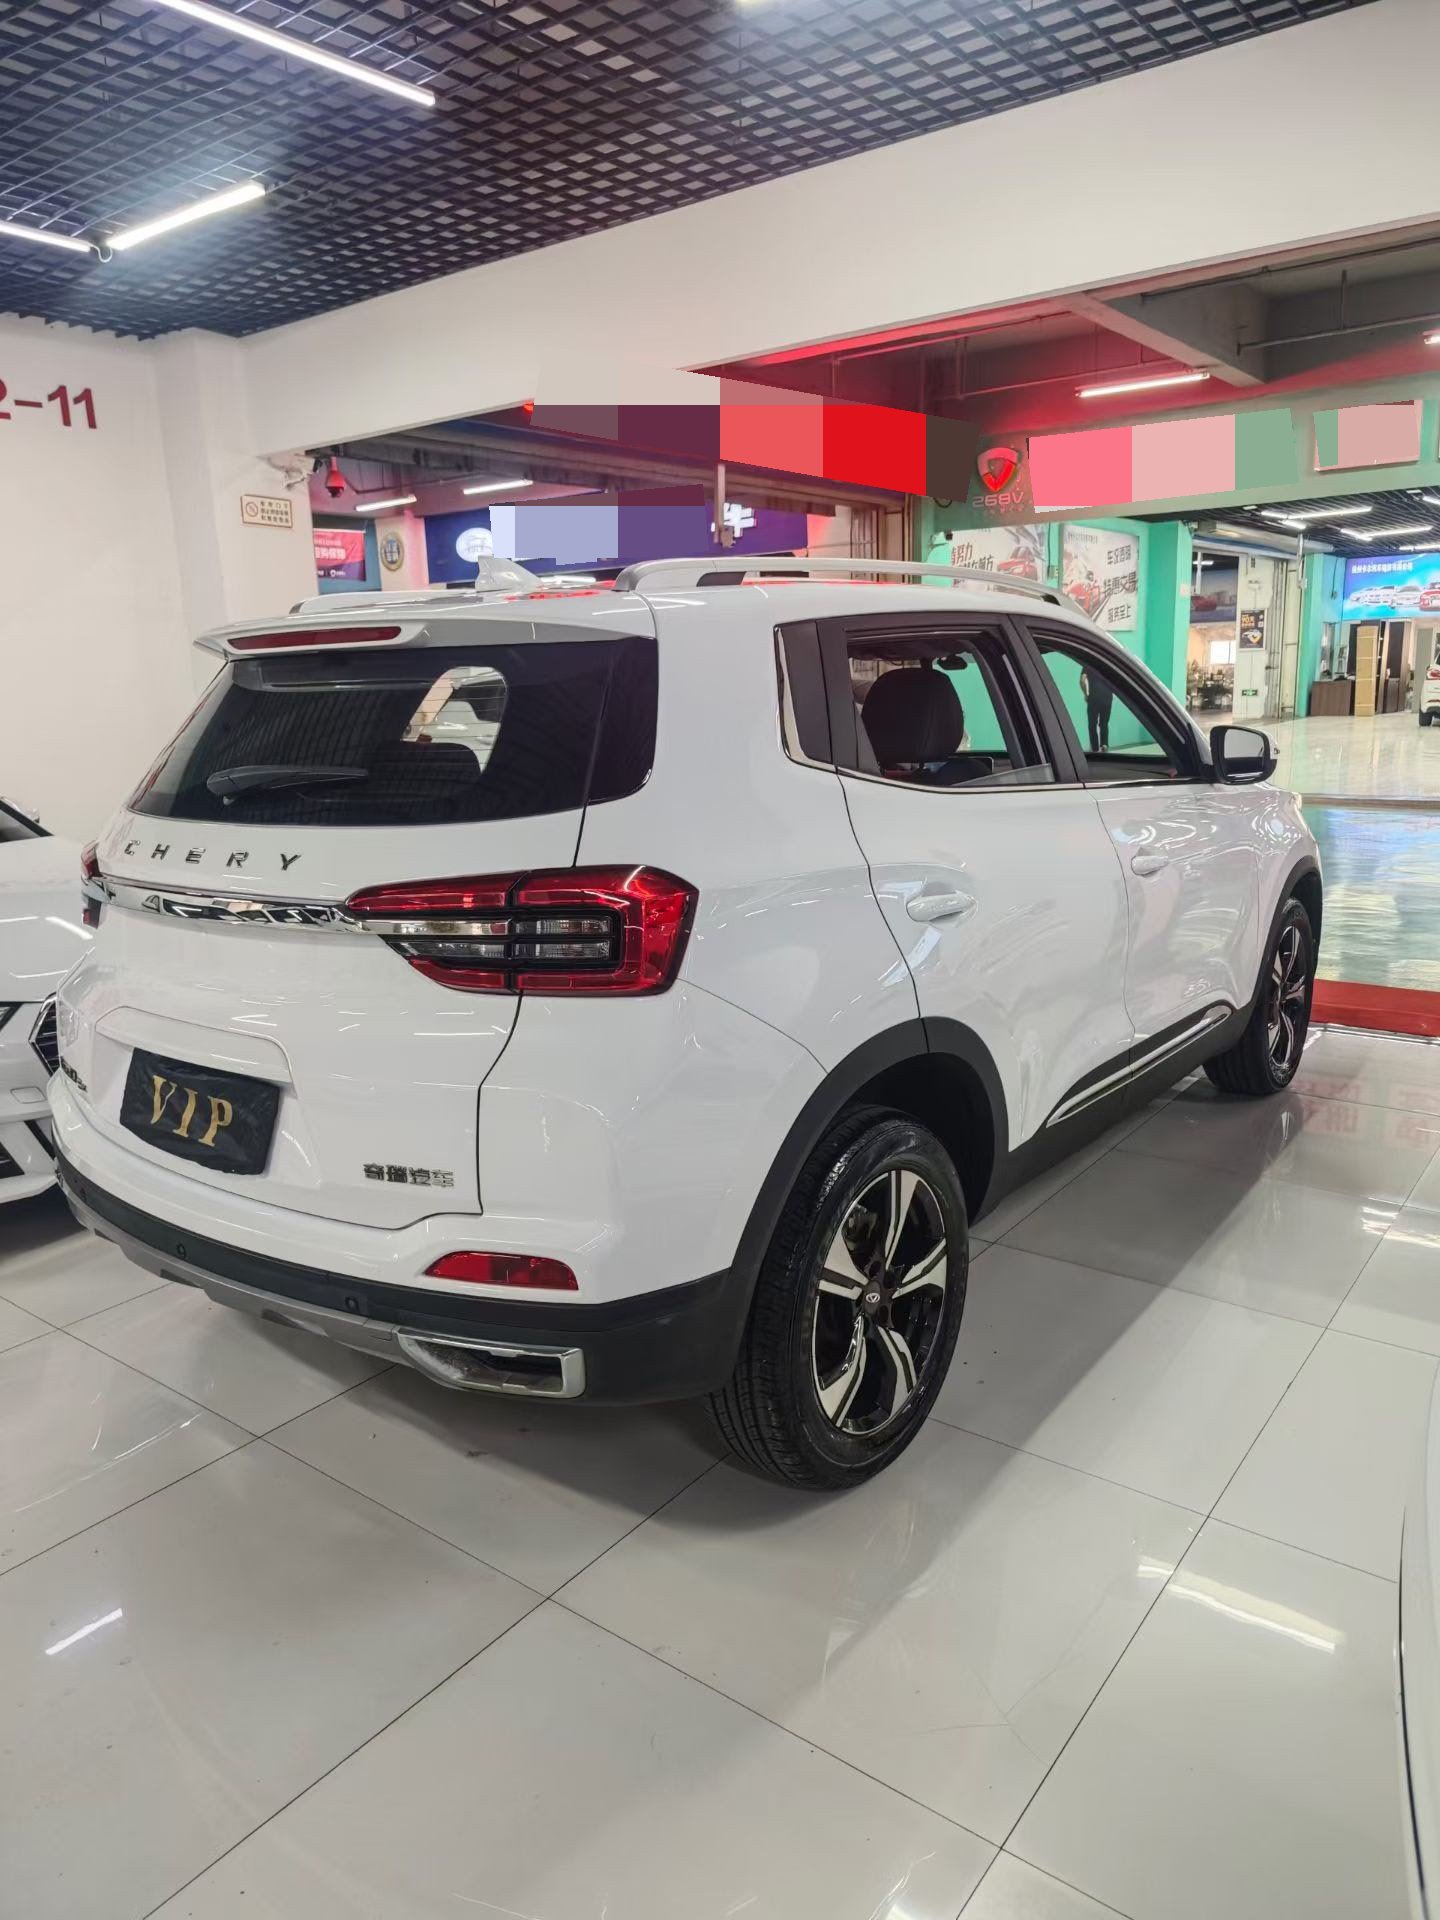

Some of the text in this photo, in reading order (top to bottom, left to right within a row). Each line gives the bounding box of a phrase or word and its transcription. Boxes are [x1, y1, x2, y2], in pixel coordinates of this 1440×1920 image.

[972, 491, 1024, 508] 268V
[124, 839, 301, 871] CHERY
[151, 1075, 232, 1146] VIP
